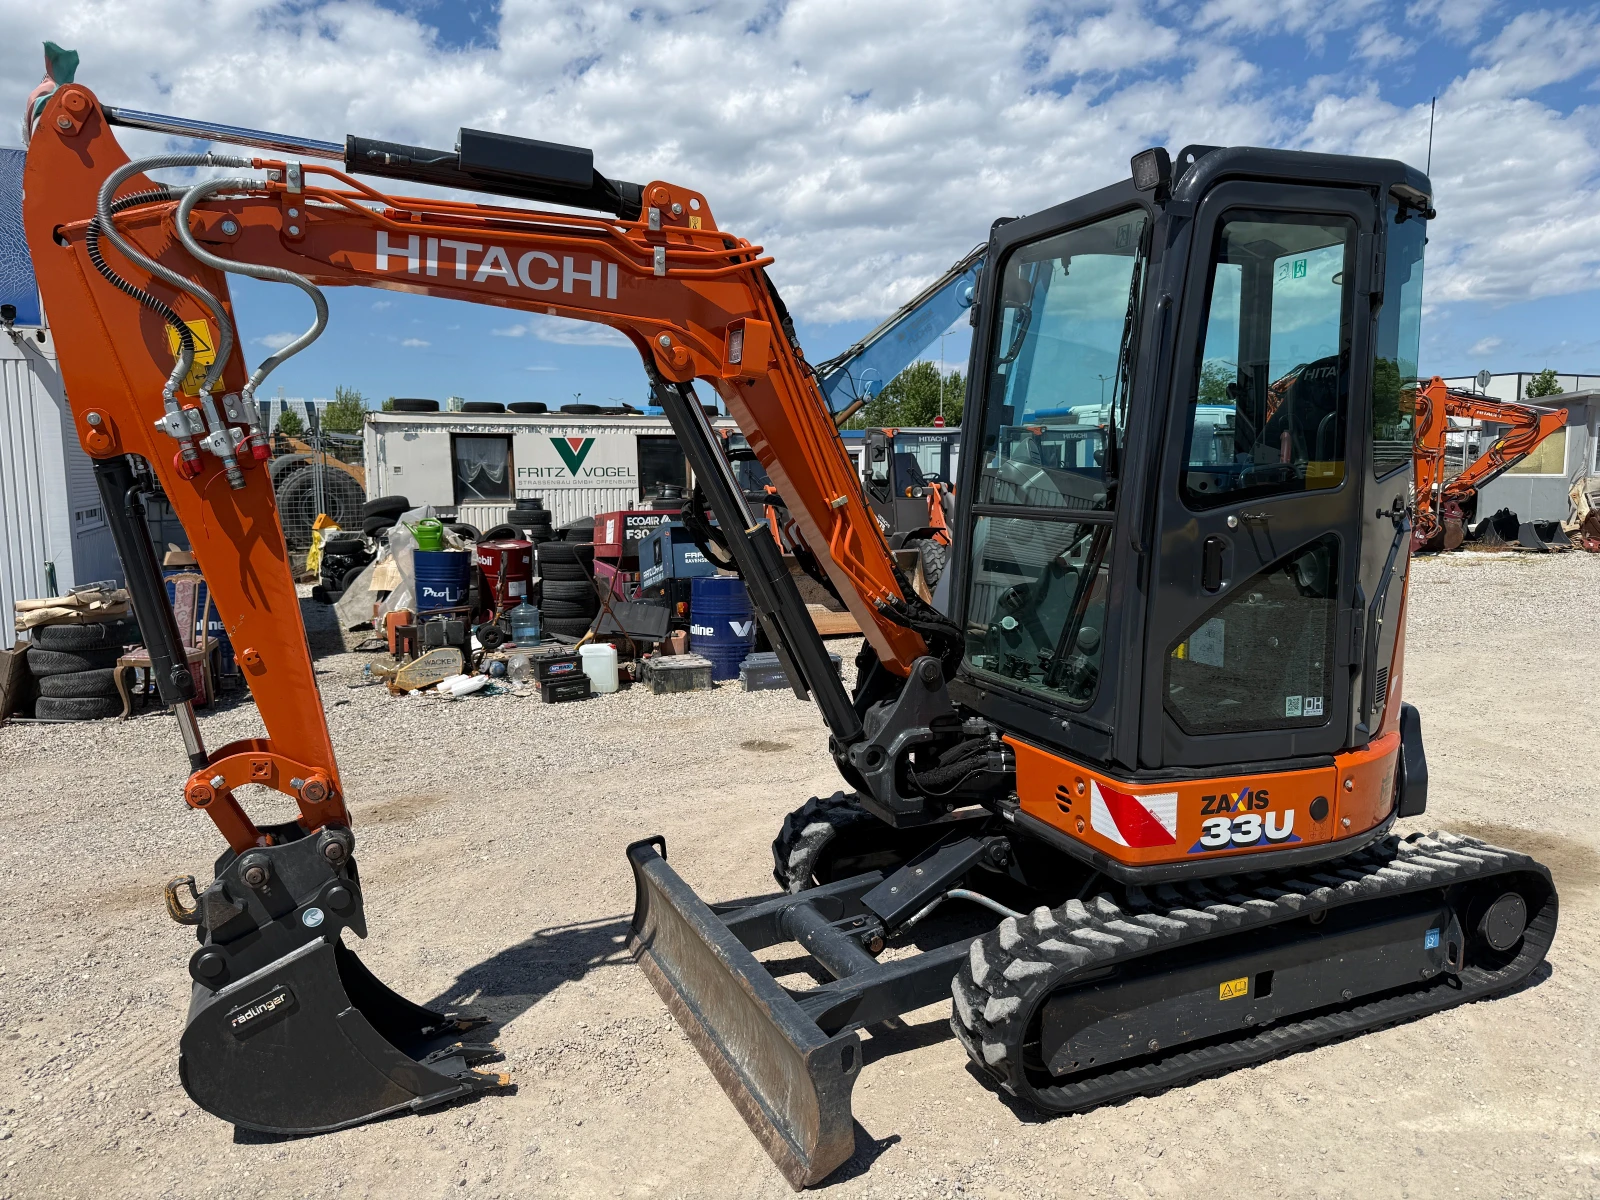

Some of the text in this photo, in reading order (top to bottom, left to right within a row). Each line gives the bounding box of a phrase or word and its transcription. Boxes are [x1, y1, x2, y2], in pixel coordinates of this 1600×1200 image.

[376, 230, 618, 299] HITACHI
[1304, 365, 1339, 381] HITA
[517, 467, 636, 477] FRITZ VOGEL
[626, 516, 660, 526] ECOAIR
[1200, 787, 1269, 816] ZAXIS
[1199, 809, 1295, 851] 33U
